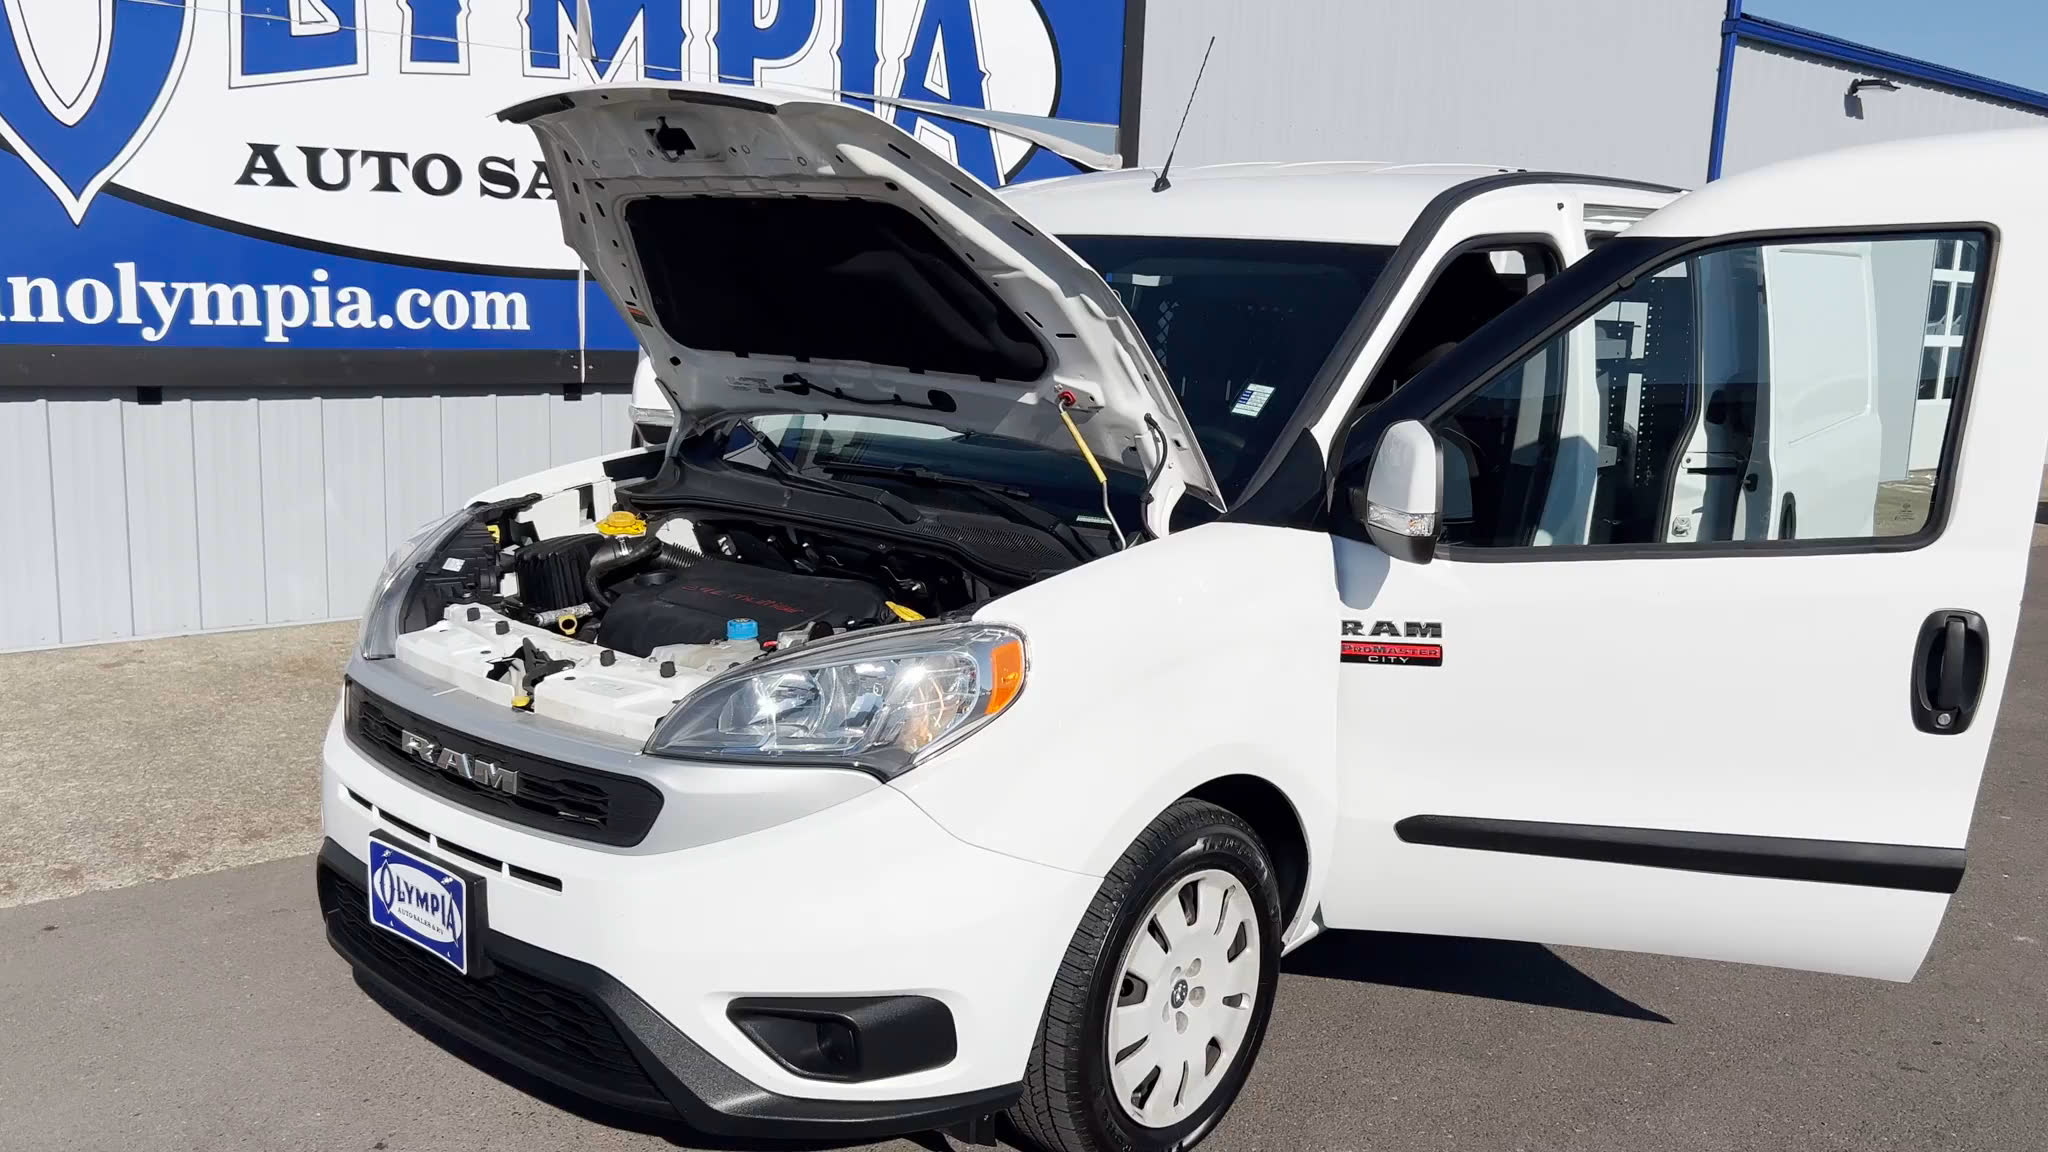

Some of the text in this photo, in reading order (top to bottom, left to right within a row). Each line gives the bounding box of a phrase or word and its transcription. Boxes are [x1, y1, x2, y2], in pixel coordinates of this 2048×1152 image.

[234, 142, 463, 197] AUTO
[0, 262, 531, 342] nolympia.com
[1340, 620, 1443, 638] RAM
[1368, 656, 1409, 664] CITY
[401, 730, 519, 795] RAM
[380, 861, 458, 945] OLYMPIA
[397, 906, 413, 919] AUTO
